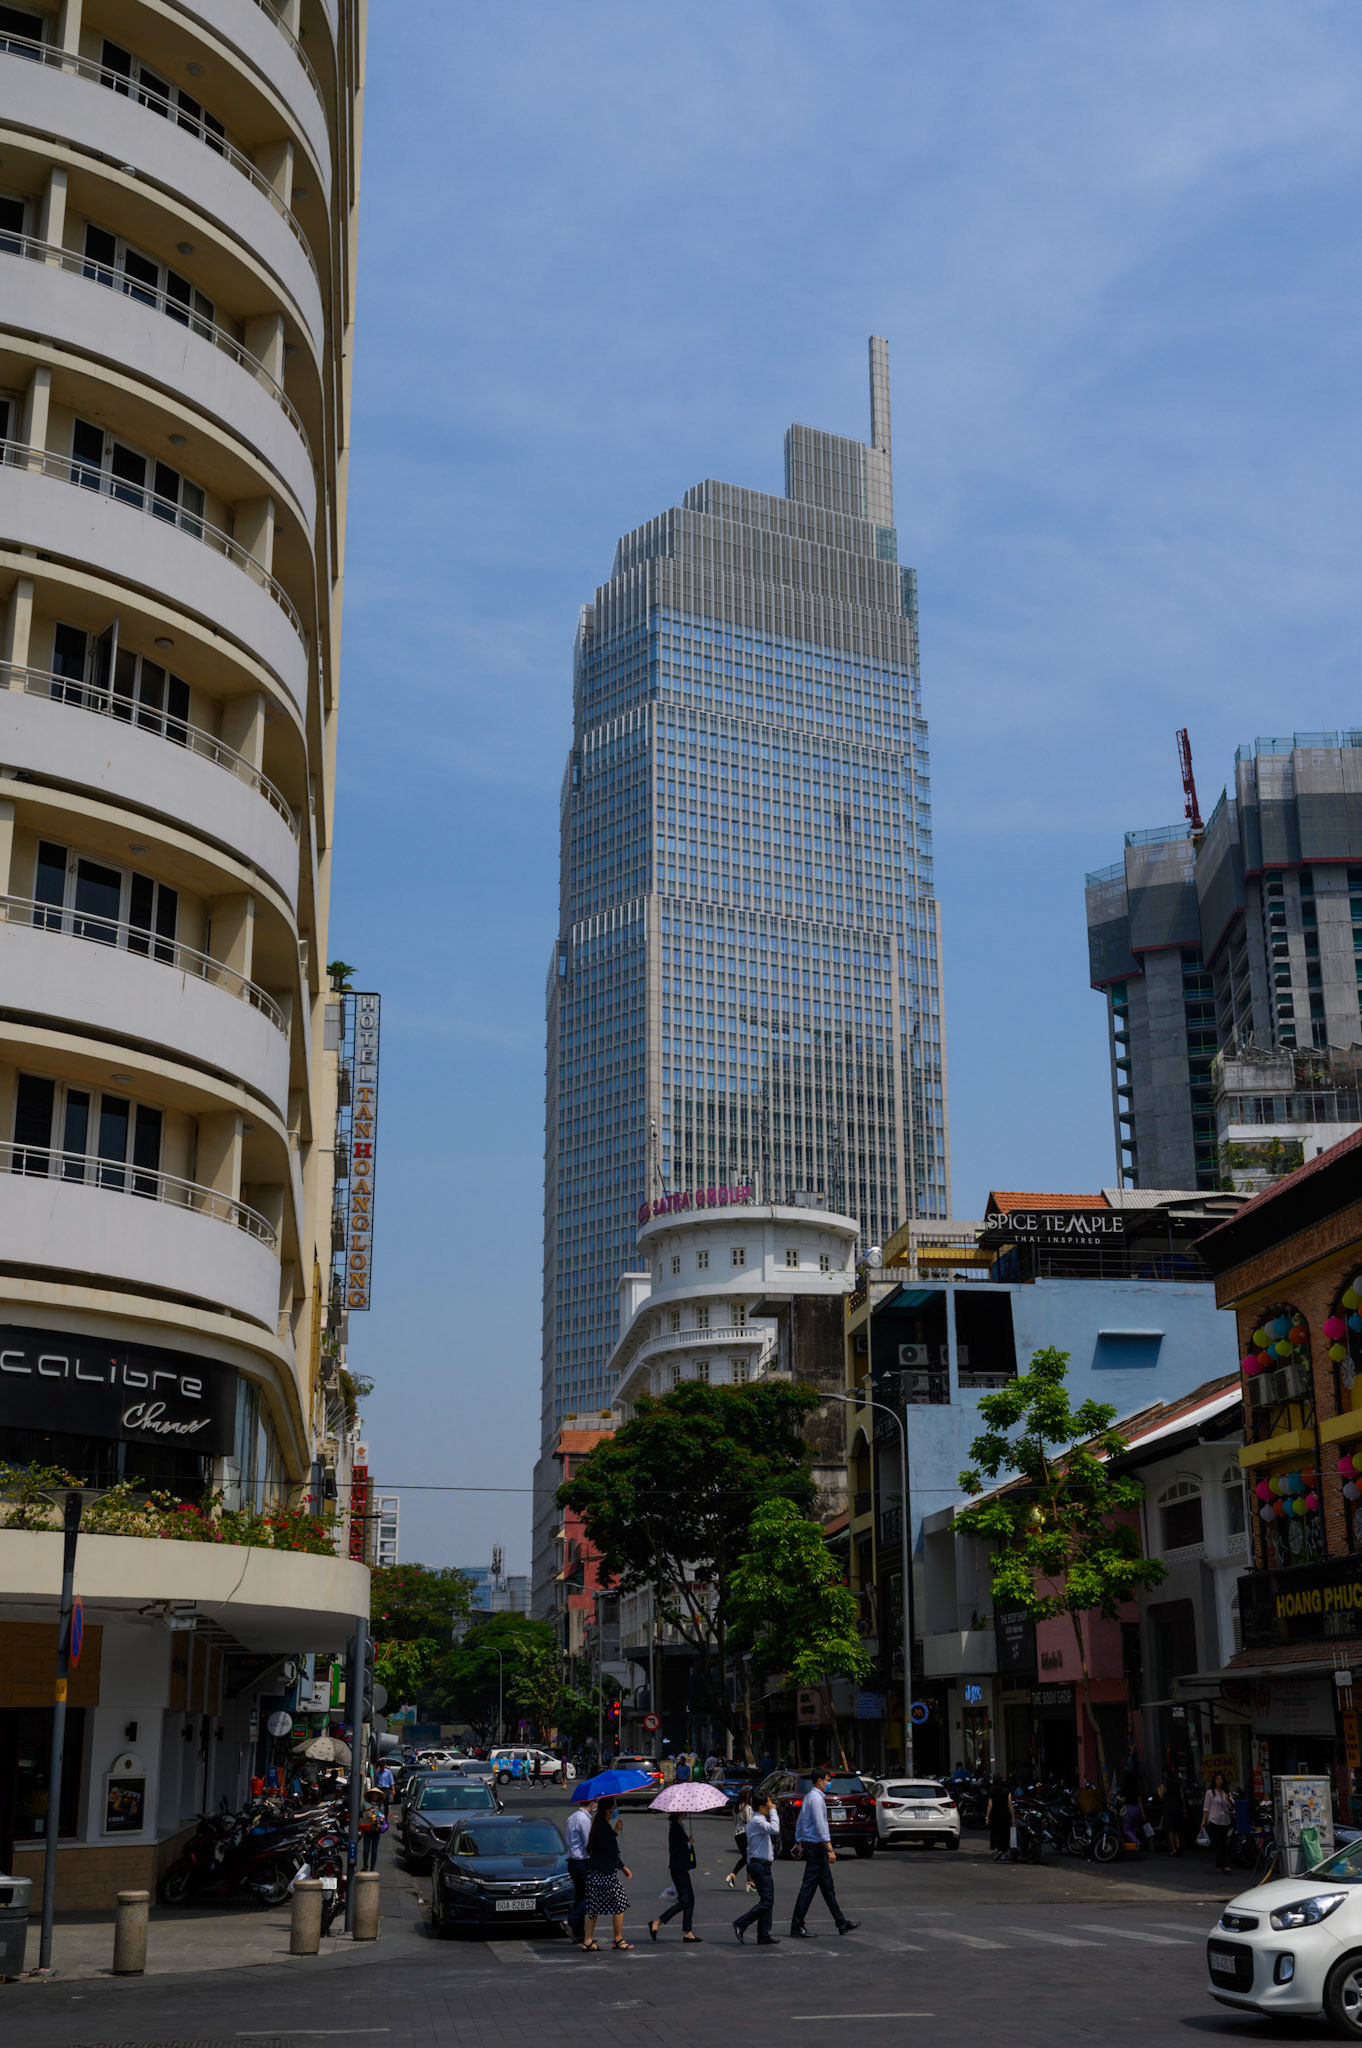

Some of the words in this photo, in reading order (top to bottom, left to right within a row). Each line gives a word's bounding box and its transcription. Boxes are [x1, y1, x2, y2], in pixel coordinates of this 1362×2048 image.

[358, 996, 376, 1083] HOTEL
[355, 1087, 374, 1138] TAN
[351, 1142, 372, 1232] HOANG
[653, 1192, 690, 1215] SATRA
[695, 1186, 751, 1206] GROUP
[987, 1213, 1038, 1231] SPICE
[1041, 1213, 1124, 1235] TEMPLE
[1015, 1235, 1041, 1243] THAI
[1048, 1236, 1101, 1245] INSPIRED
[347, 1234, 368, 1308] LONG
[1276, 1588, 1322, 1618] HOANG
[1031, 1691, 1042, 1704] THE
[1043, 1690, 1056, 1704] BODY
